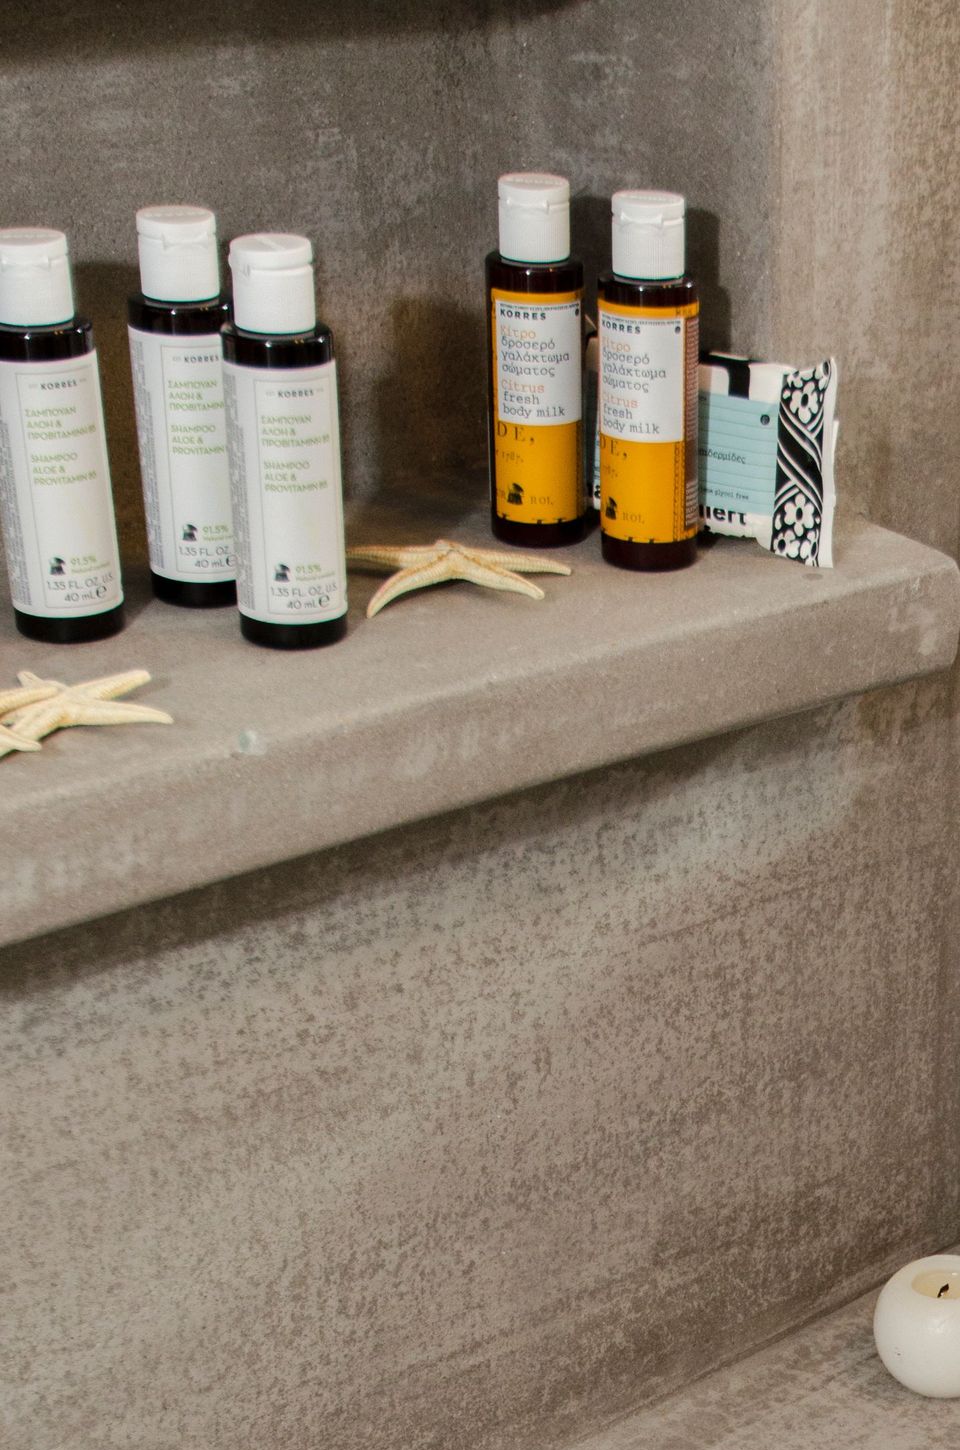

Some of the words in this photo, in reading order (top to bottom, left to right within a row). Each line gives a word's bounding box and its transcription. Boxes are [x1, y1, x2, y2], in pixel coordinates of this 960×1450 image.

[500, 308, 546, 320] KORRES
[601, 319, 641, 334] KORRES
[501, 335, 556, 352] δροσερό
[501, 349, 570, 364] γαλάκτωμα
[502, 362, 555, 378] σώματος
[501, 379, 545, 394] Citrus
[503, 390, 540, 405] fresh
[169, 401, 225, 411] ΠΡΟΒΙΤΑΜΙΝ
[503, 403, 532, 418] body
[537, 406, 566, 417] milk
[603, 403, 633, 419] fresh
[603, 415, 626, 433] body
[629, 422, 660, 434] milk
